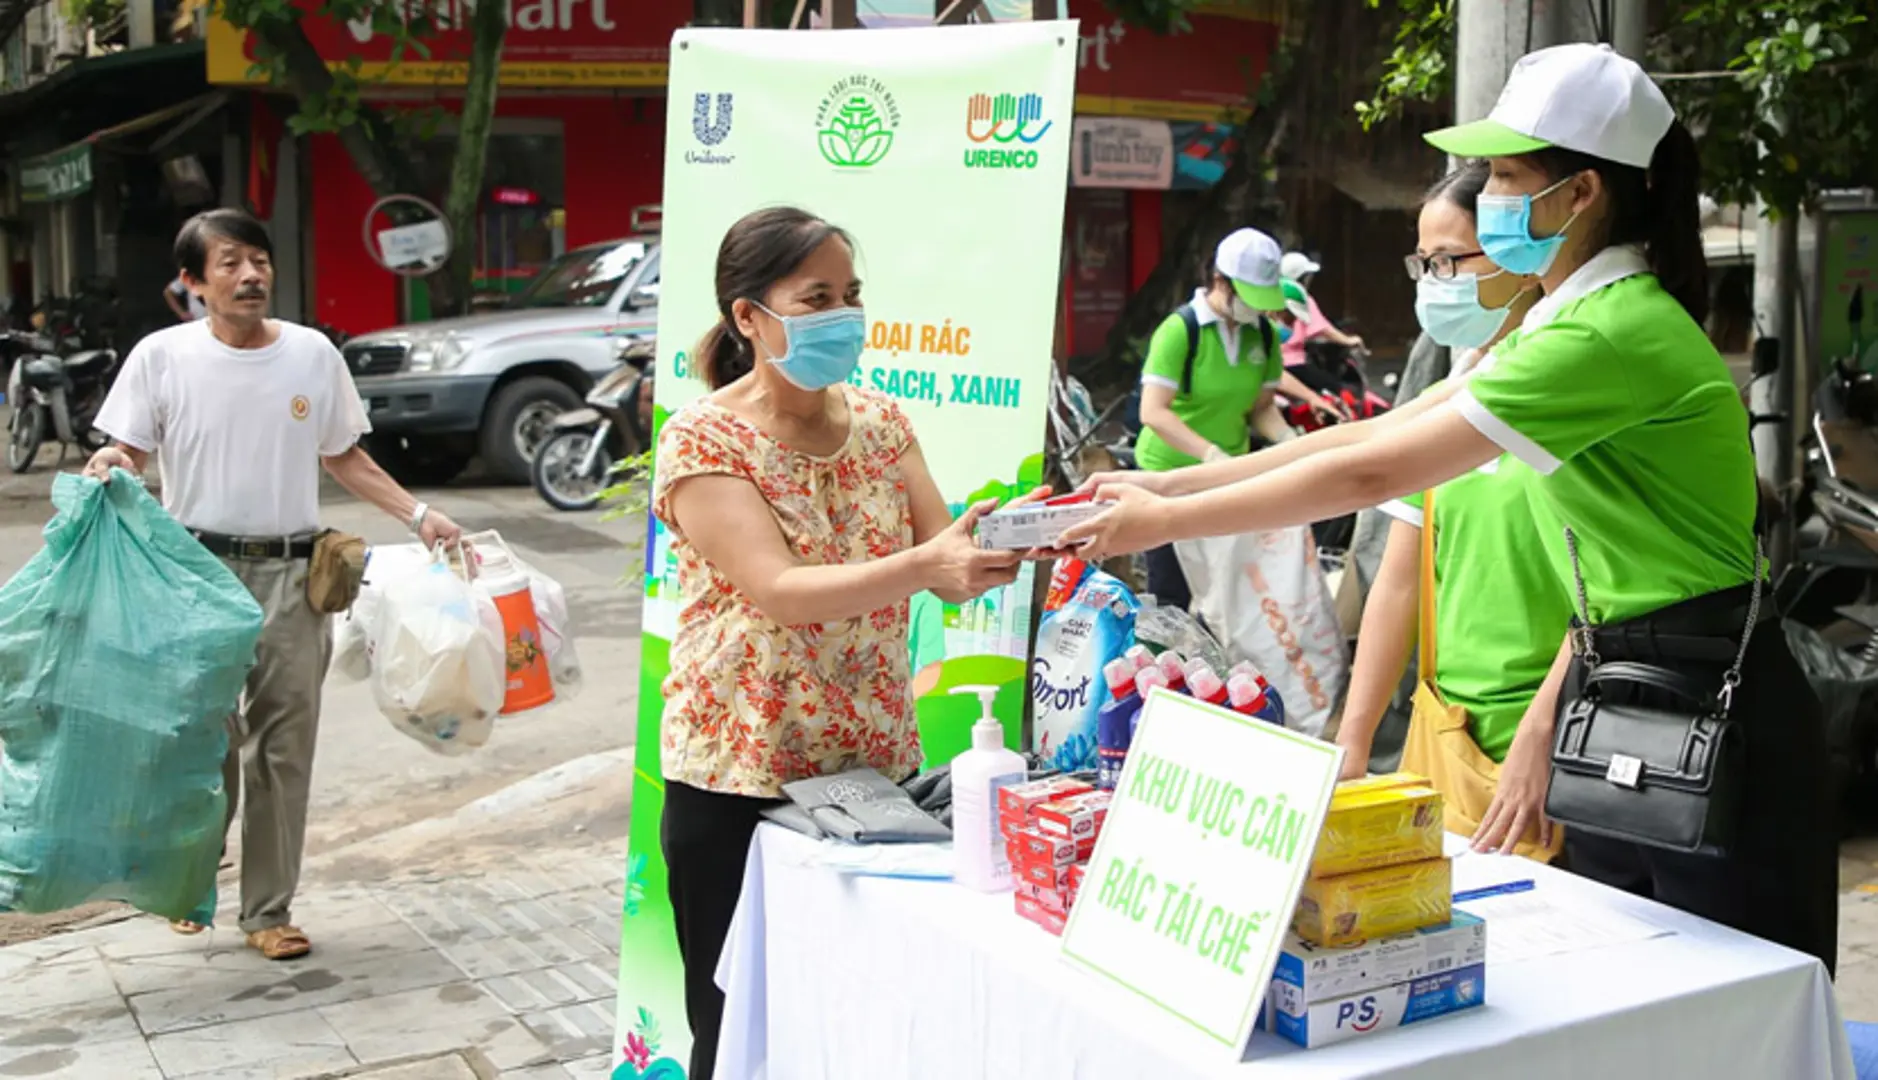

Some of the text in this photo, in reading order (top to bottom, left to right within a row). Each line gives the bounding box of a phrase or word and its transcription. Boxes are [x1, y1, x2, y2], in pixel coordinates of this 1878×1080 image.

[963, 148, 1039, 169] URENCO
[864, 318, 971, 357] OẠI RÁC
[949, 373, 1021, 408] XANH
[1130, 752, 1190, 814] KHU
[1242, 793, 1307, 865] CÂN
[1097, 856, 1273, 976] RÁC TÁI CHẾ
